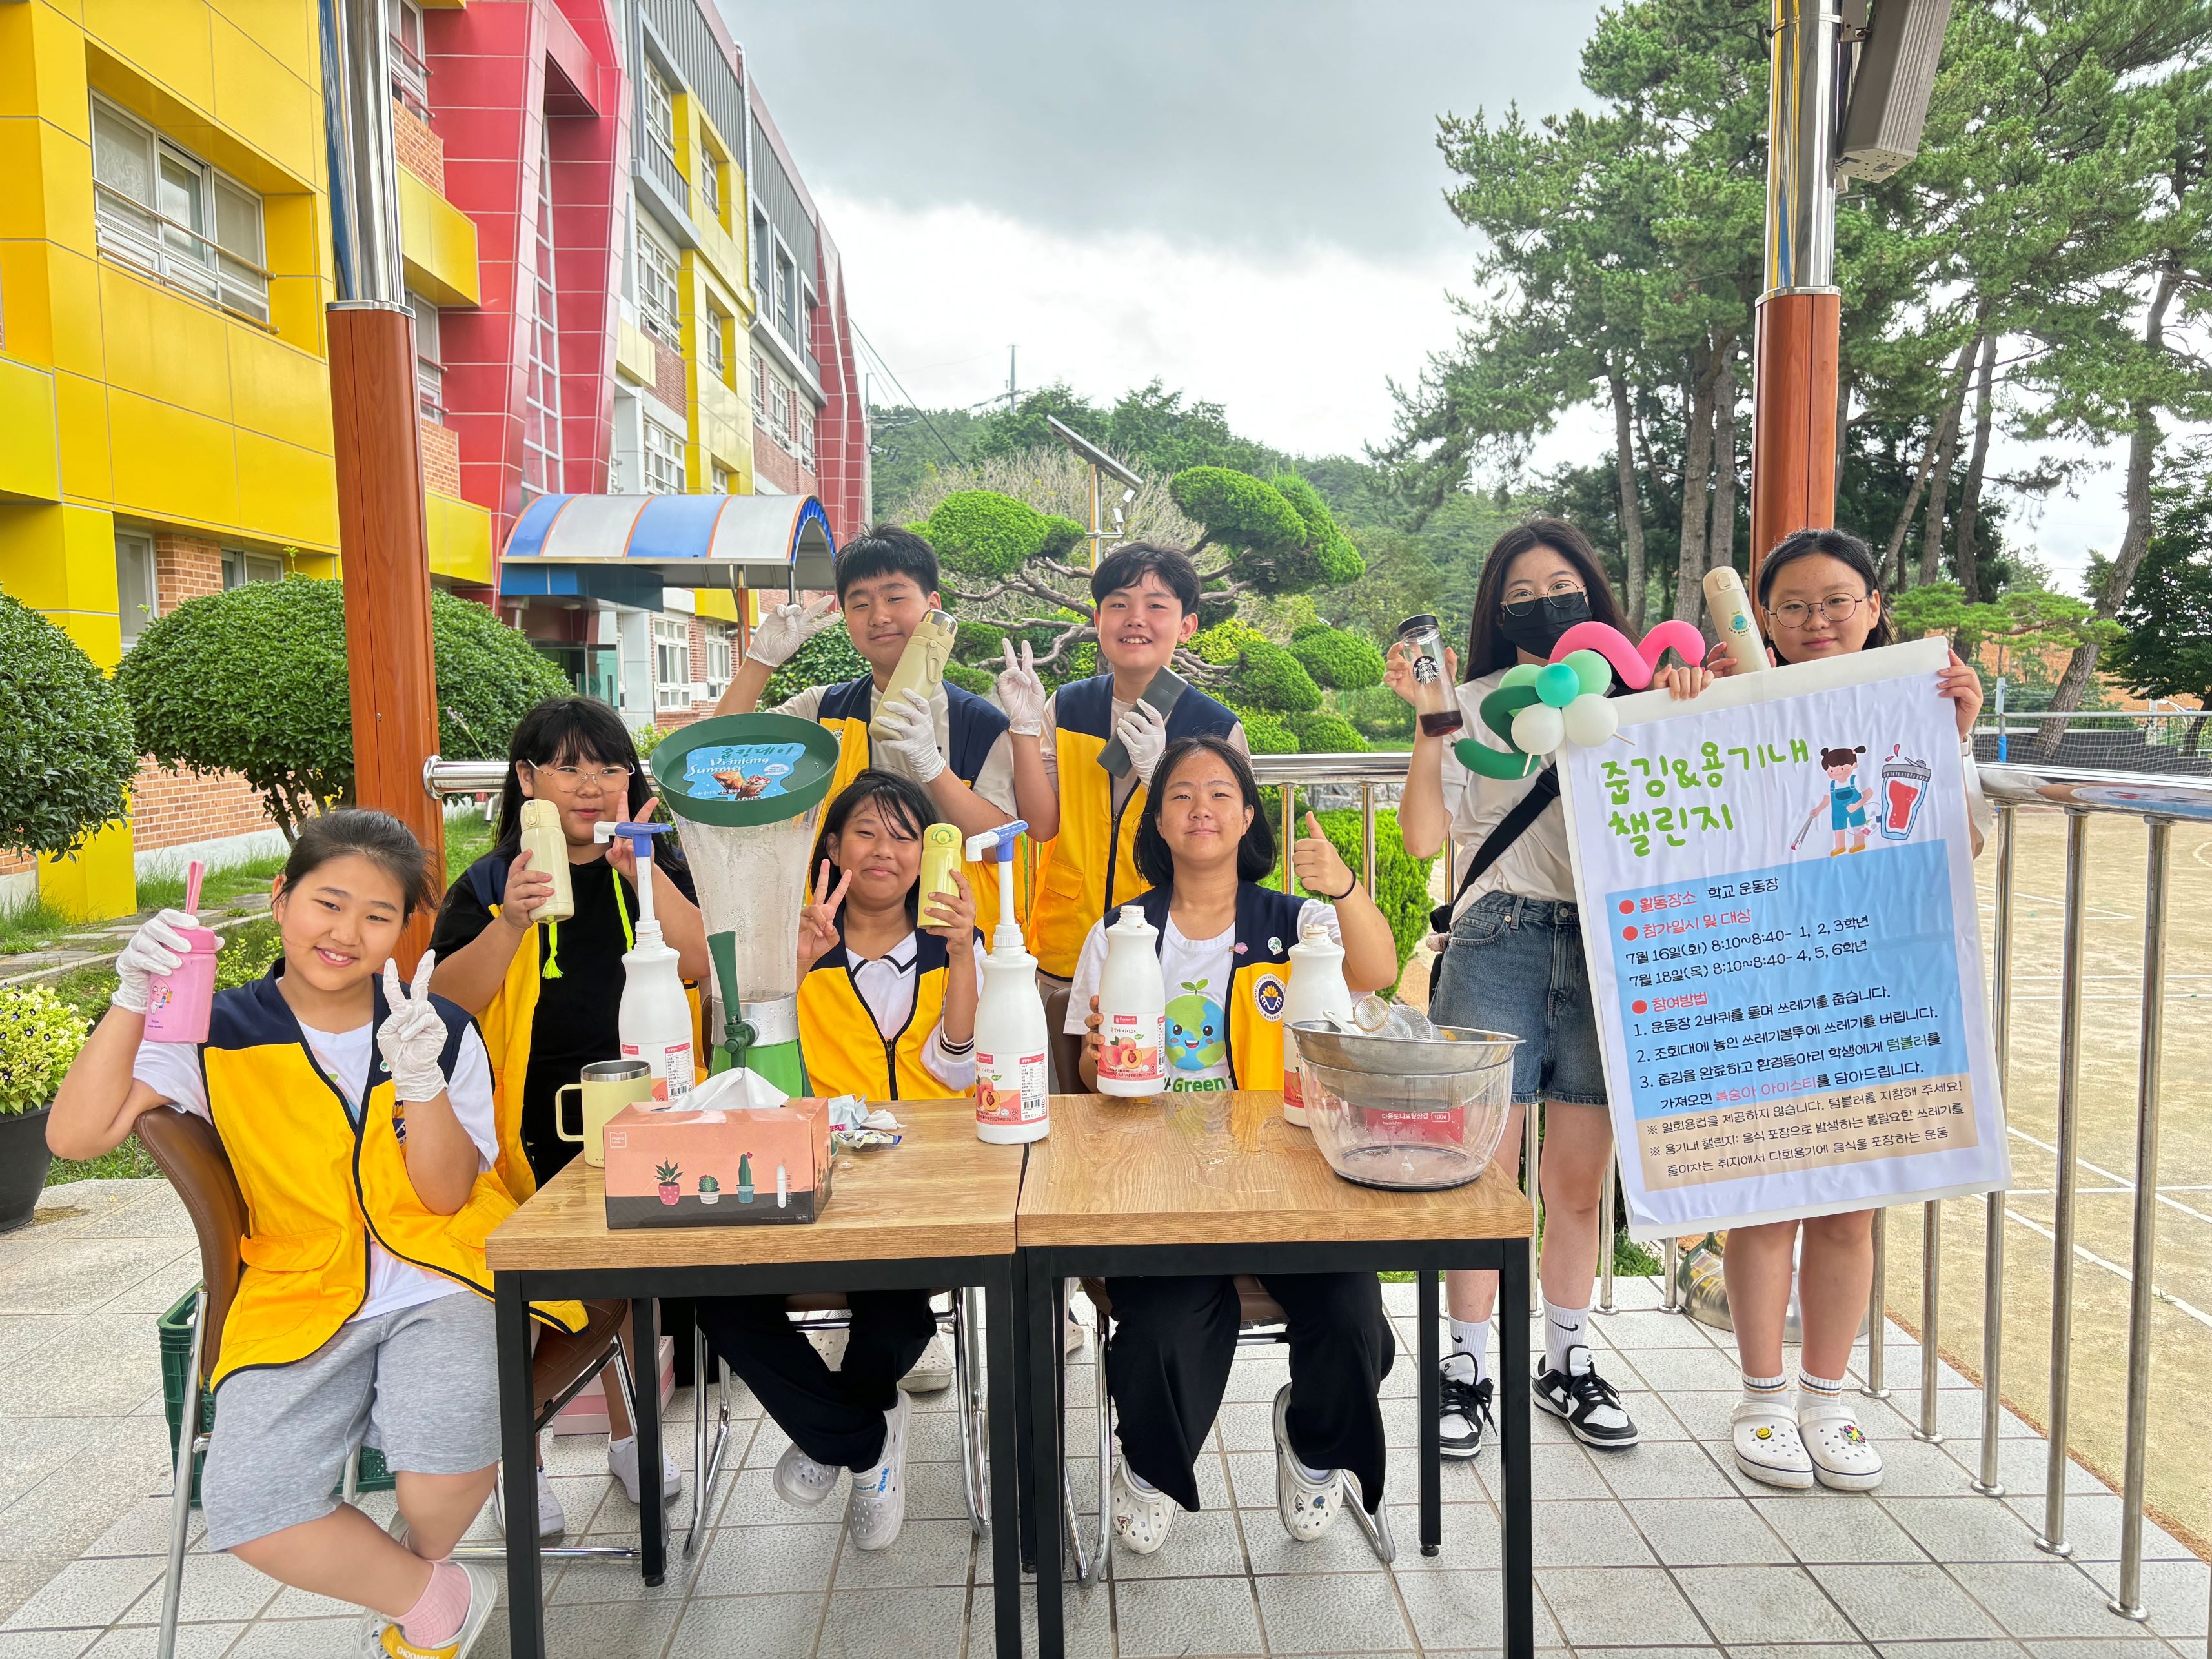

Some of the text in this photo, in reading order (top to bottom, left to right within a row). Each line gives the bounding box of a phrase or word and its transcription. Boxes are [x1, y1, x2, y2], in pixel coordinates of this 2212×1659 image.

[688, 764, 745, 777] Summer
[710, 757, 769, 766] Drinking
[1601, 738, 1809, 805] 줍깅&용기내
[1608, 804, 1734, 857] 챌린지
[1638, 878, 1778, 914] 활동장소 학교 운동장
[1625, 951, 1649, 965] 7월
[1652, 942, 1707, 962] 16일(화)
[1800, 926, 1811, 939] 1,
[1818, 923, 1831, 935] 2,
[1833, 915, 1869, 932] 3학년
[1642, 909, 1752, 939] 참가일시 및 대상
[1629, 973, 1652, 988] 7월
[1656, 965, 1708, 984] 18일(목)
[1796, 950, 1811, 962] 4,
[1814, 947, 1828, 959] 5,
[1831, 939, 1867, 957] 6학년
[1634, 986, 1890, 1037] 1. 운동장 2바퀴를 돌며 쓰레기를 줍습니다.
[1652, 992, 1708, 1013] 참여방법
[1636, 1006, 1938, 1063] 2. 조회대에 놓인 쓰레기봉투에 쓰레기를 버립니다.
[1173, 1077, 1226, 1092] Green
[1639, 1032, 1941, 1089] 3. 줍깅을 완료하고 환경동아리 학생에게 텀블러를
[1660, 1061, 1924, 1110] 가져오면 복숭아 아이스티를 담아드립니다.
[1661, 1115, 1719, 1134] 일회용컵을
[1722, 1108, 1769, 1123] 제공하지
[1773, 1101, 1824, 1117] 않습니다.
[1828, 1092, 1877, 1110] 텀블러를
[1880, 1086, 1916, 1101] 지참해
[1922, 1081, 1962, 1095] 주세요!
[1665, 1141, 1699, 1155] 용기내
[1701, 1135, 1738, 1150] 챌린지:
[1743, 1131, 1765, 1144] 음식
[1768, 1124, 1812, 1140] 포장으로
[1815, 1118, 1863, 1134] 발생하는
[1867, 1110, 1913, 1126] 불필요한
[1917, 1103, 1963, 1119] 쓰레기를
[1667, 1127, 1948, 1177] 줄이자는 취지에서 다회용기에 음식을 포장하는 운동
